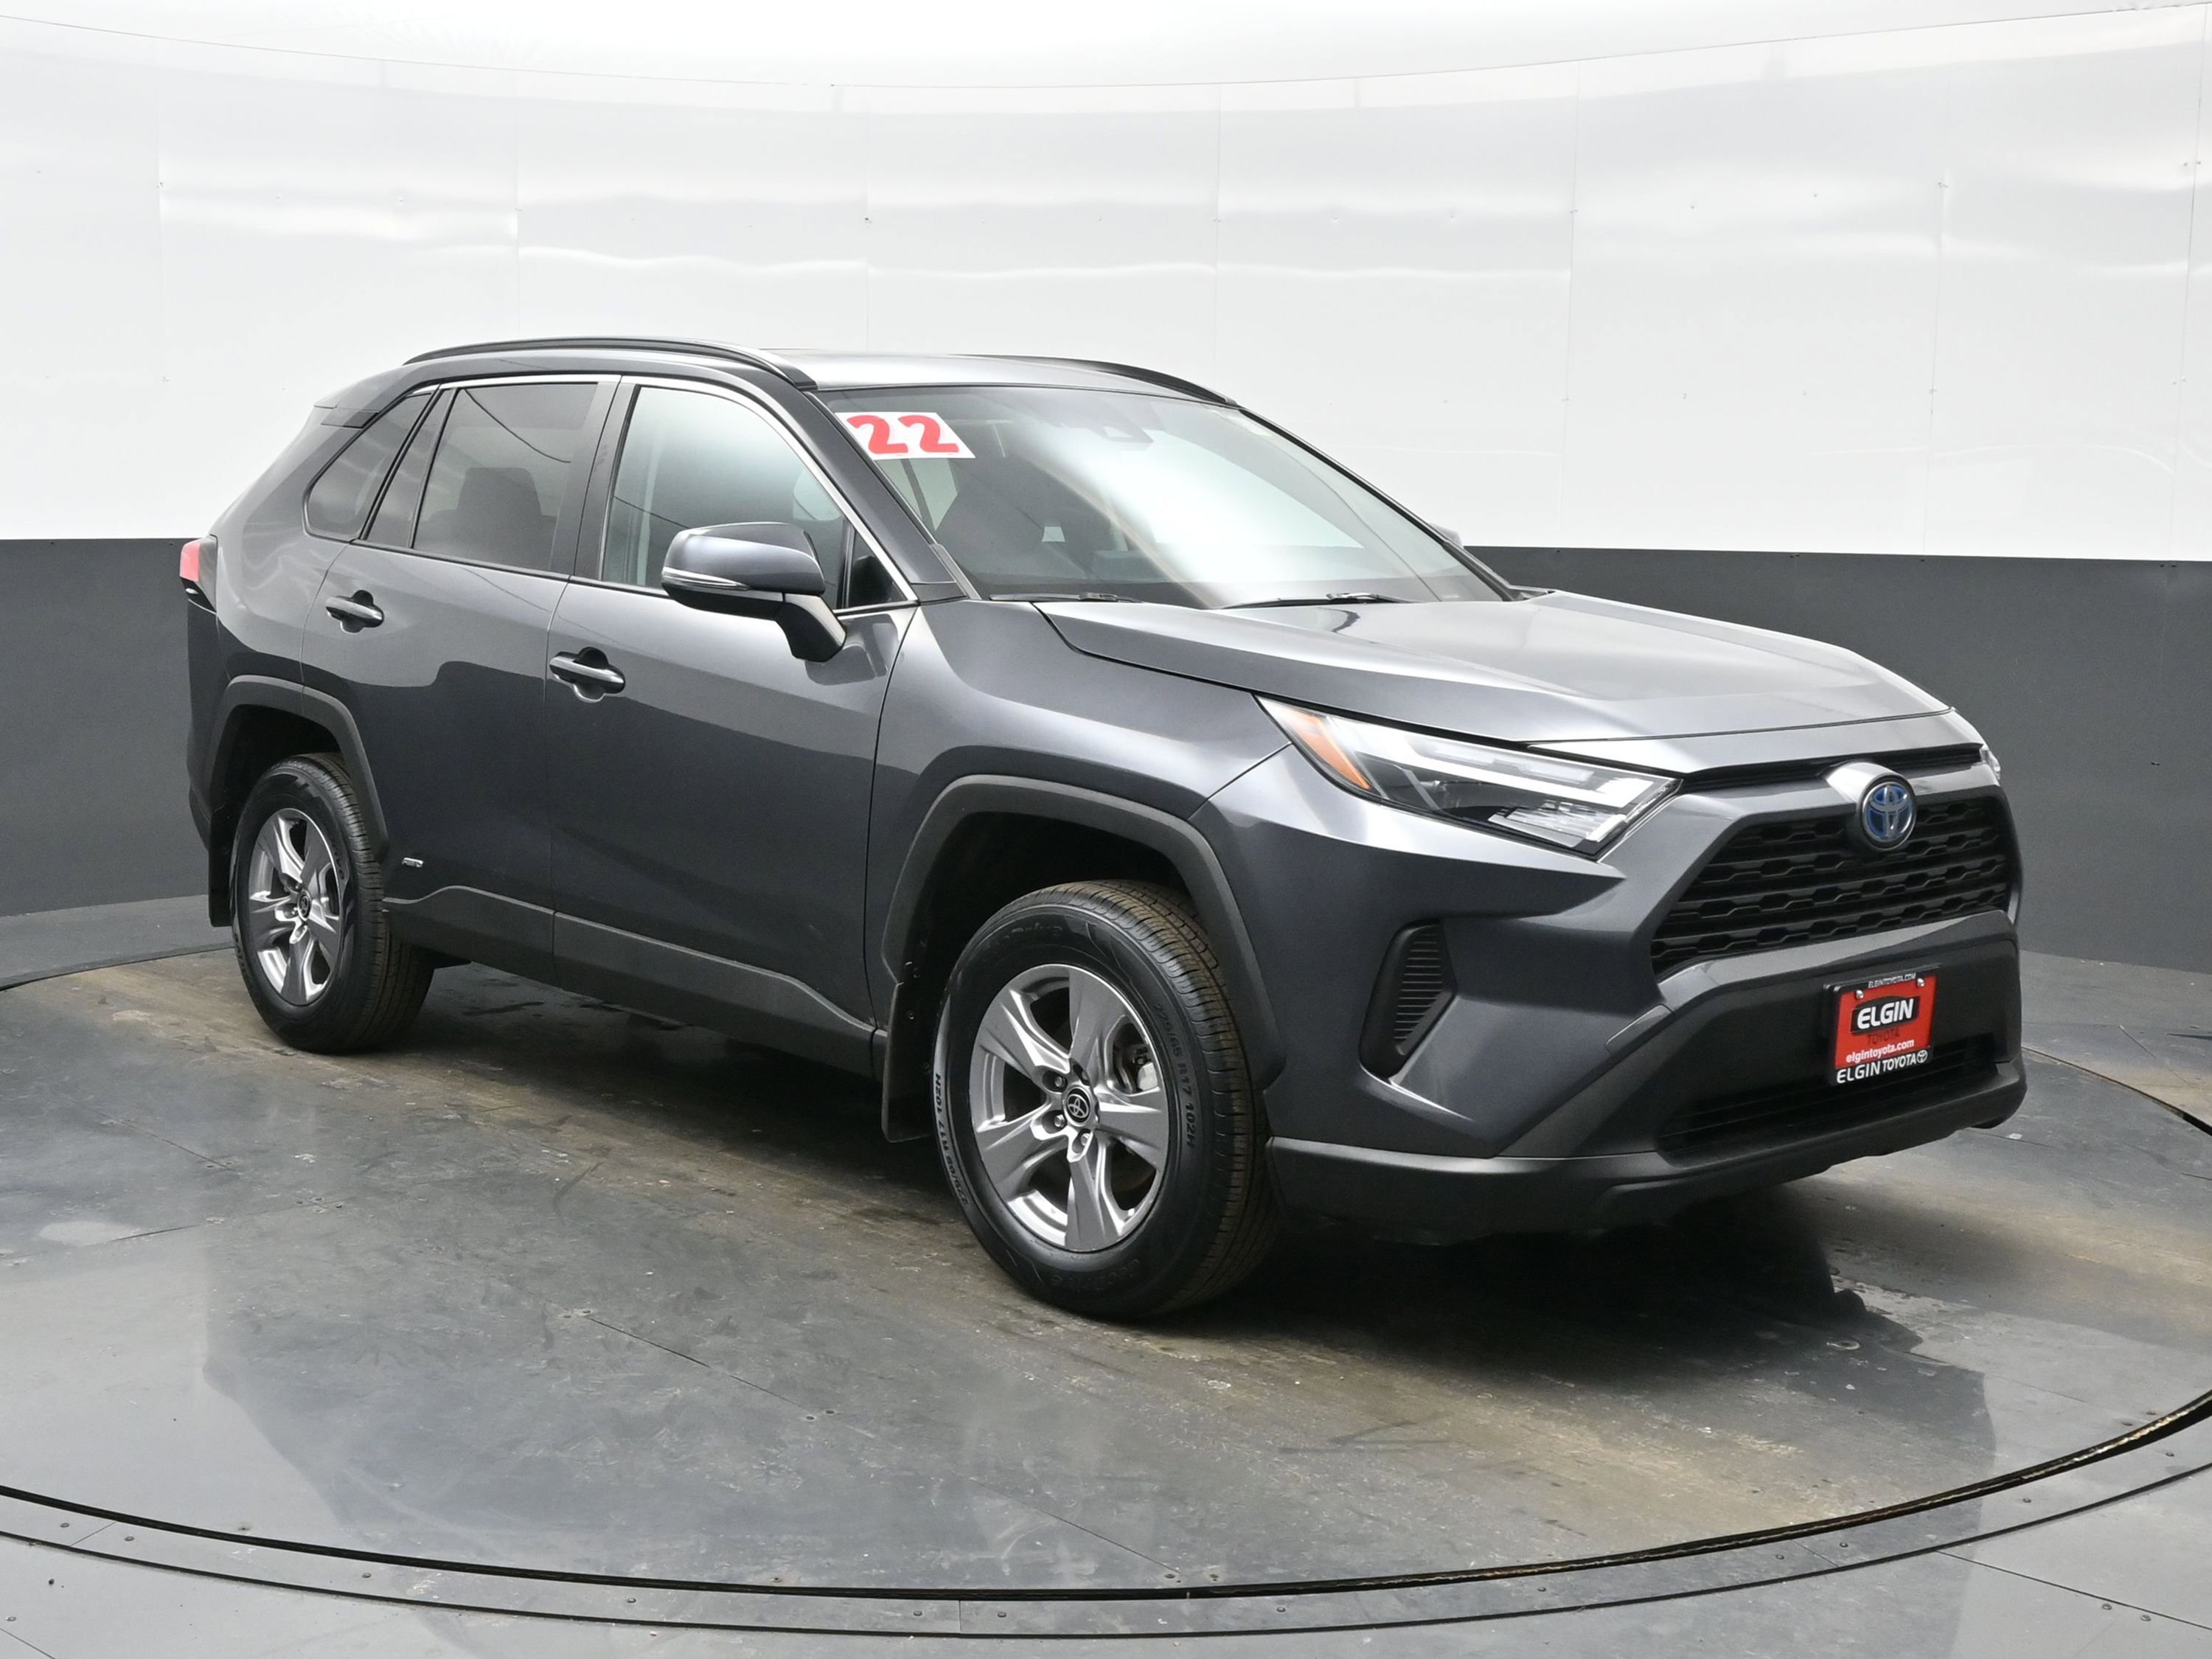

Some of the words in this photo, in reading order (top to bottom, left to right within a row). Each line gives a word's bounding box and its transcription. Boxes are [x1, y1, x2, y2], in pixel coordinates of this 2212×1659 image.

[846, 414, 959, 454] 22
[1868, 973, 1916, 989] ELGINTOYOTA.COM
[1857, 998, 1914, 1029] ELGIN
[1868, 1028, 1900, 1045] TOYOTA
[1846, 1040, 1915, 1063] elgintoyota.com
[1836, 1060, 1880, 1084] ELGIN
[1882, 1053, 1916, 1072] TOYOTA
